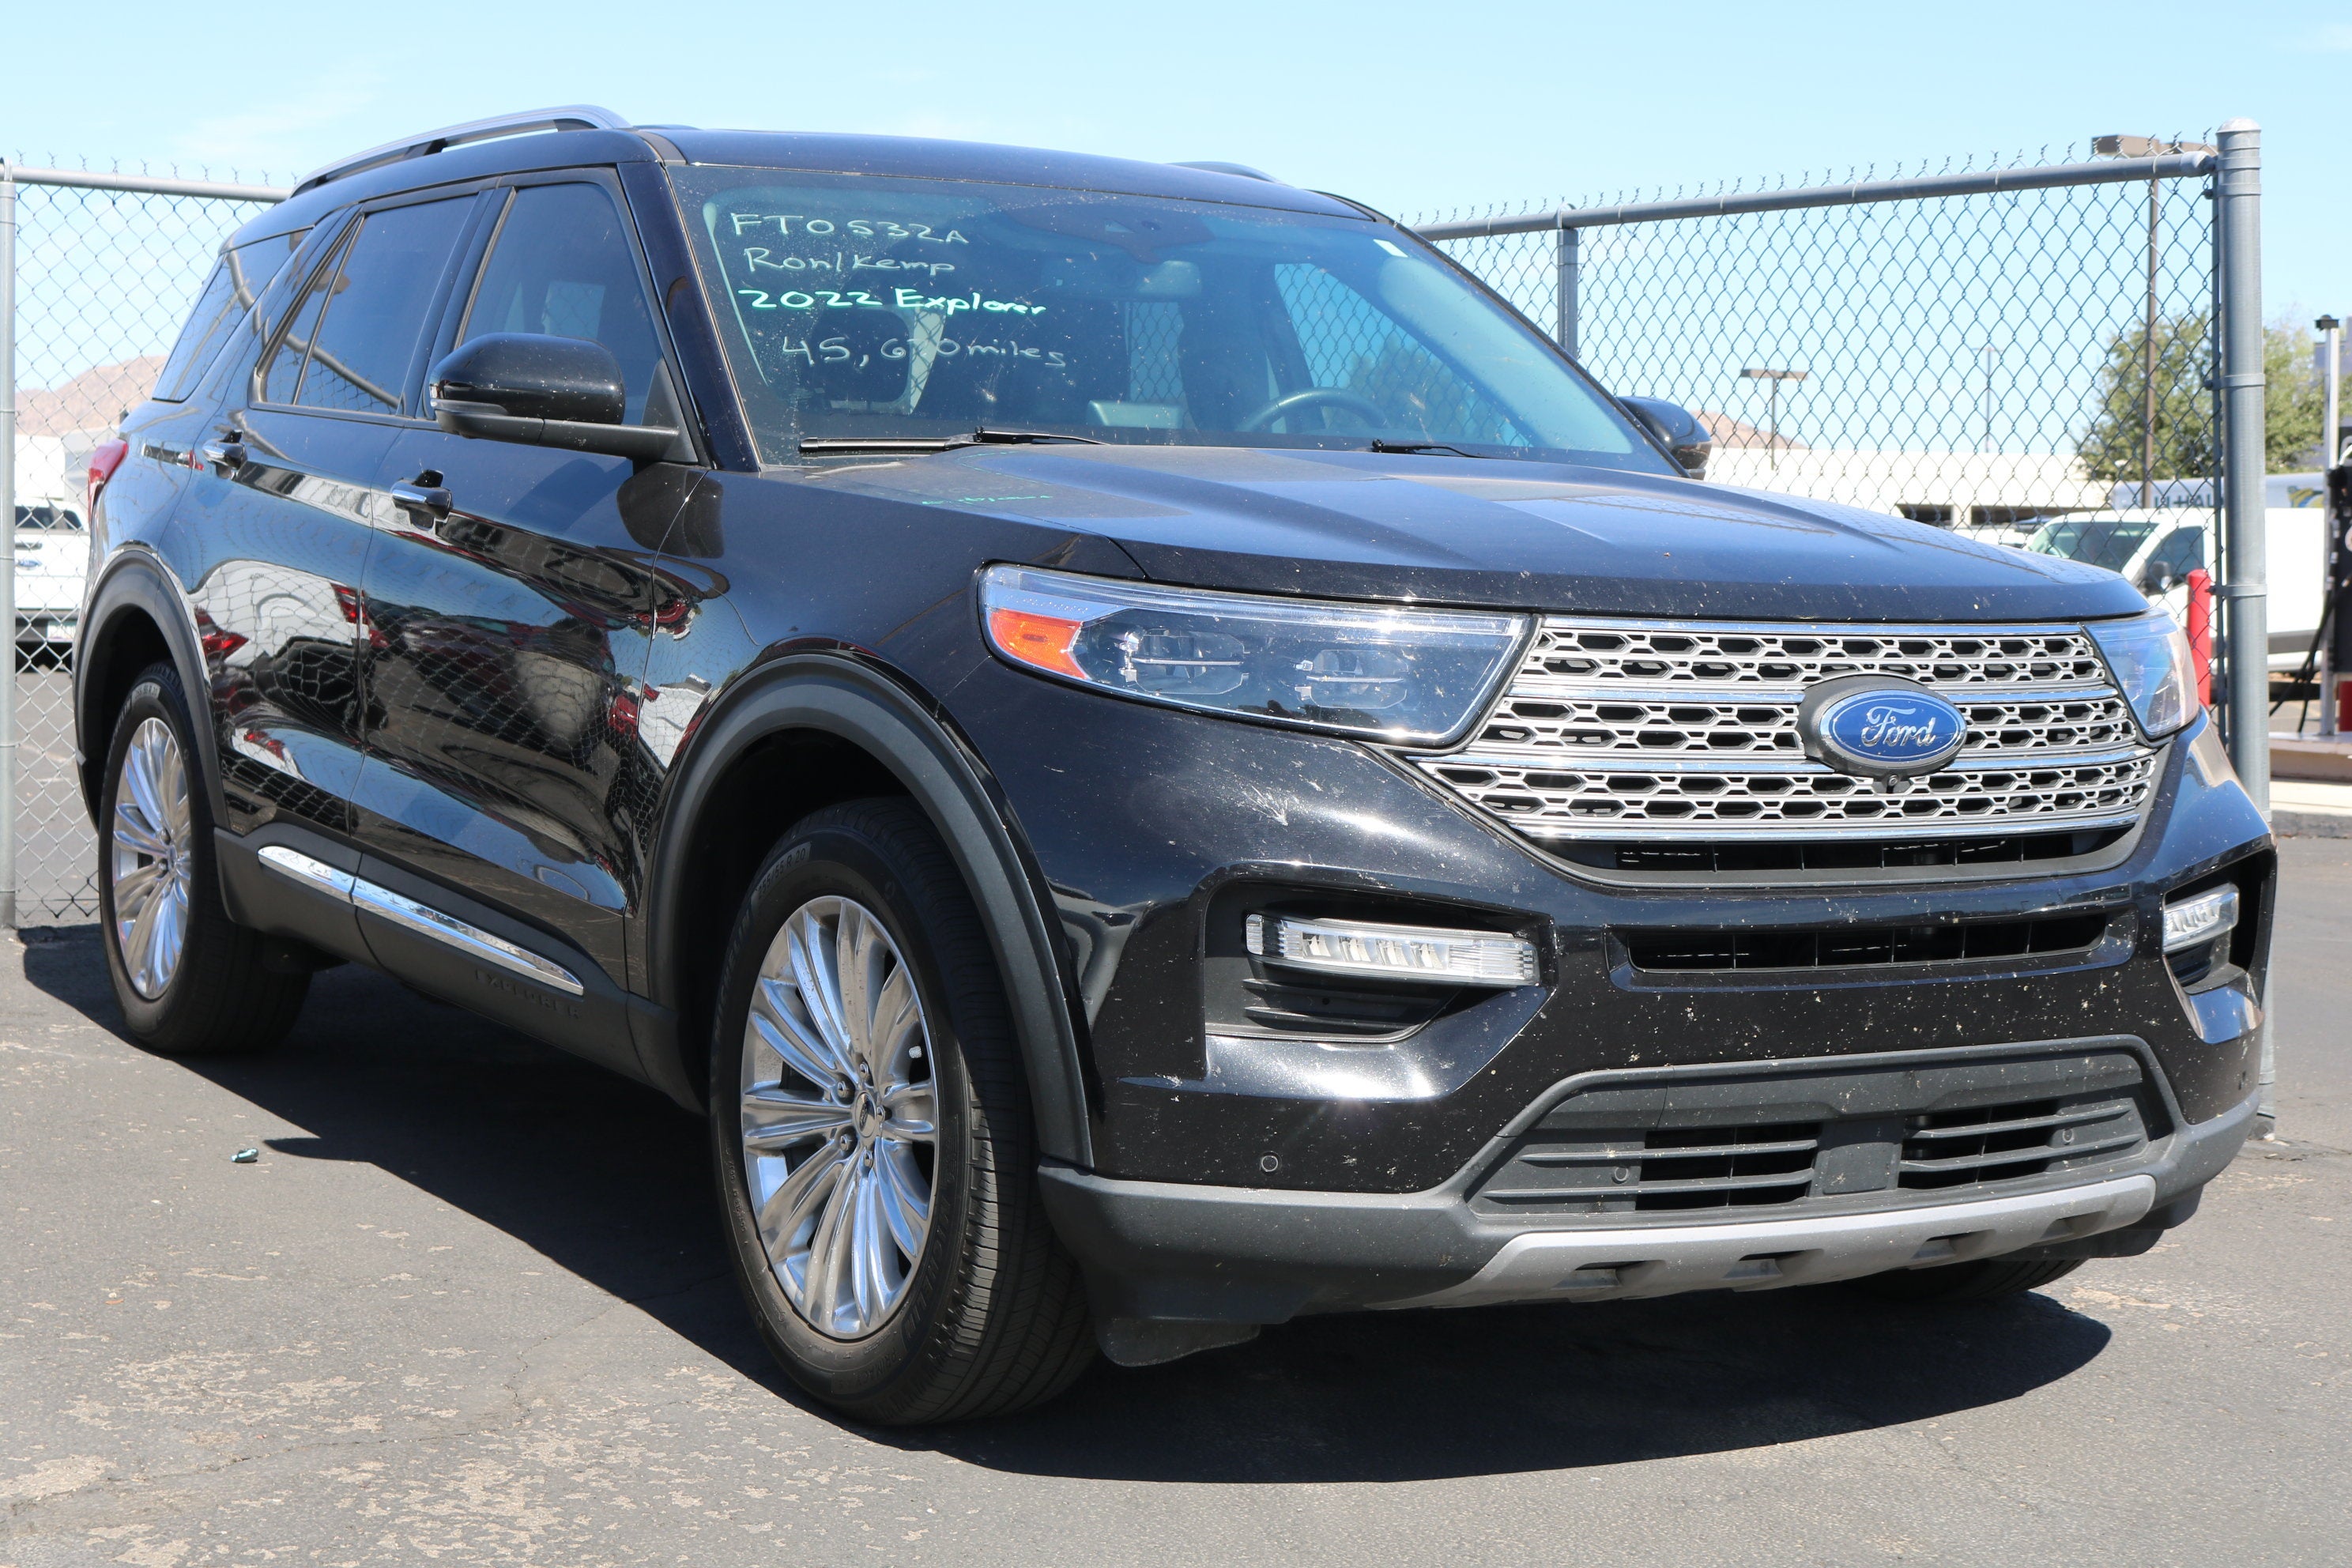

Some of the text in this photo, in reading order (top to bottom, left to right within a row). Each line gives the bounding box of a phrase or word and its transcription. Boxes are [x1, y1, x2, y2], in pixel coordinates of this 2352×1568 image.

[737, 288, 1047, 315] 2022 Explorer
[1861, 705, 1936, 748] Ford
